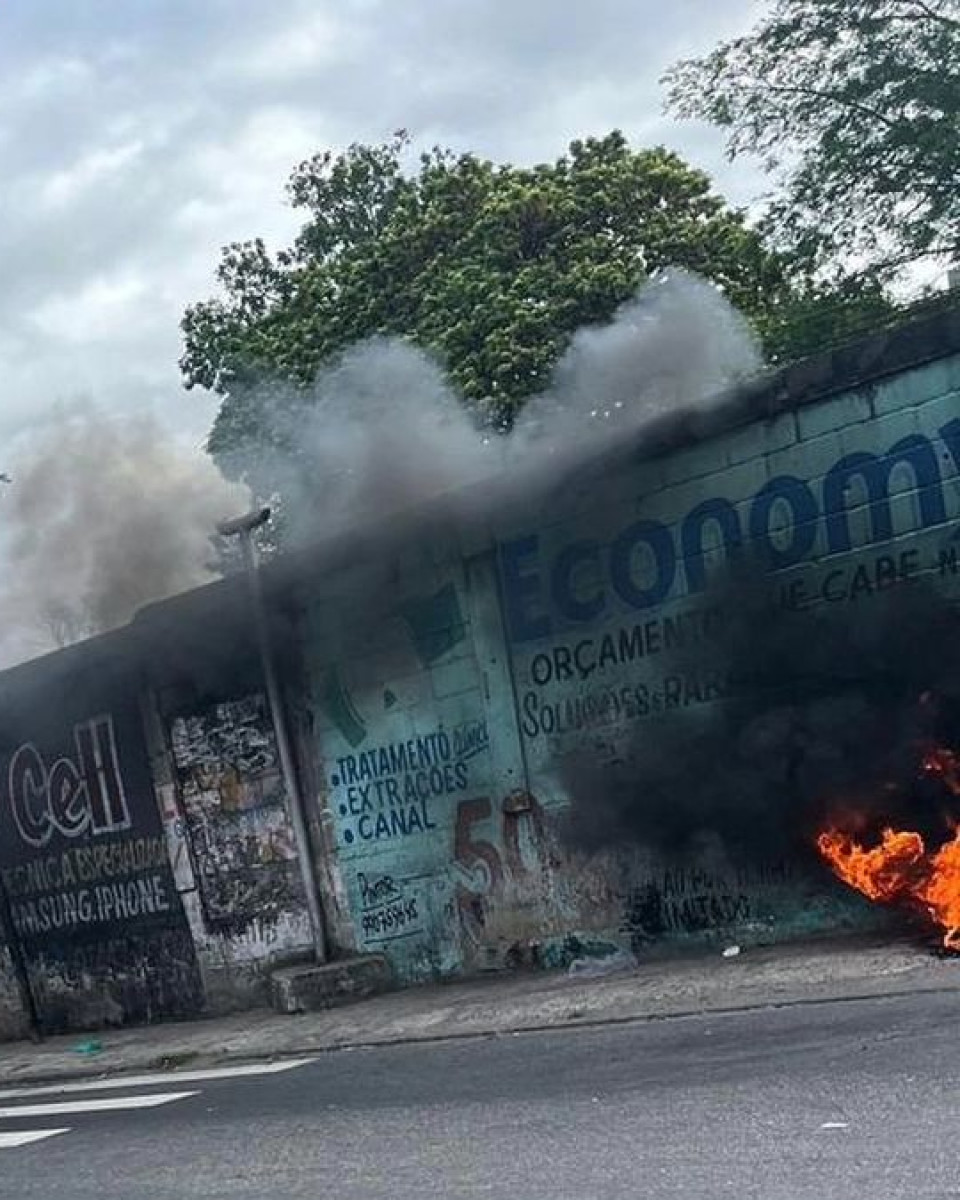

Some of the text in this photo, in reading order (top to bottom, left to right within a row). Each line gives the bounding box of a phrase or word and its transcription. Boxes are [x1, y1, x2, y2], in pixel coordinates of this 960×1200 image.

[9, 714, 132, 848] Cell
[337, 728, 450, 785] TRATAMENTO
[358, 801, 436, 840] CANAL
